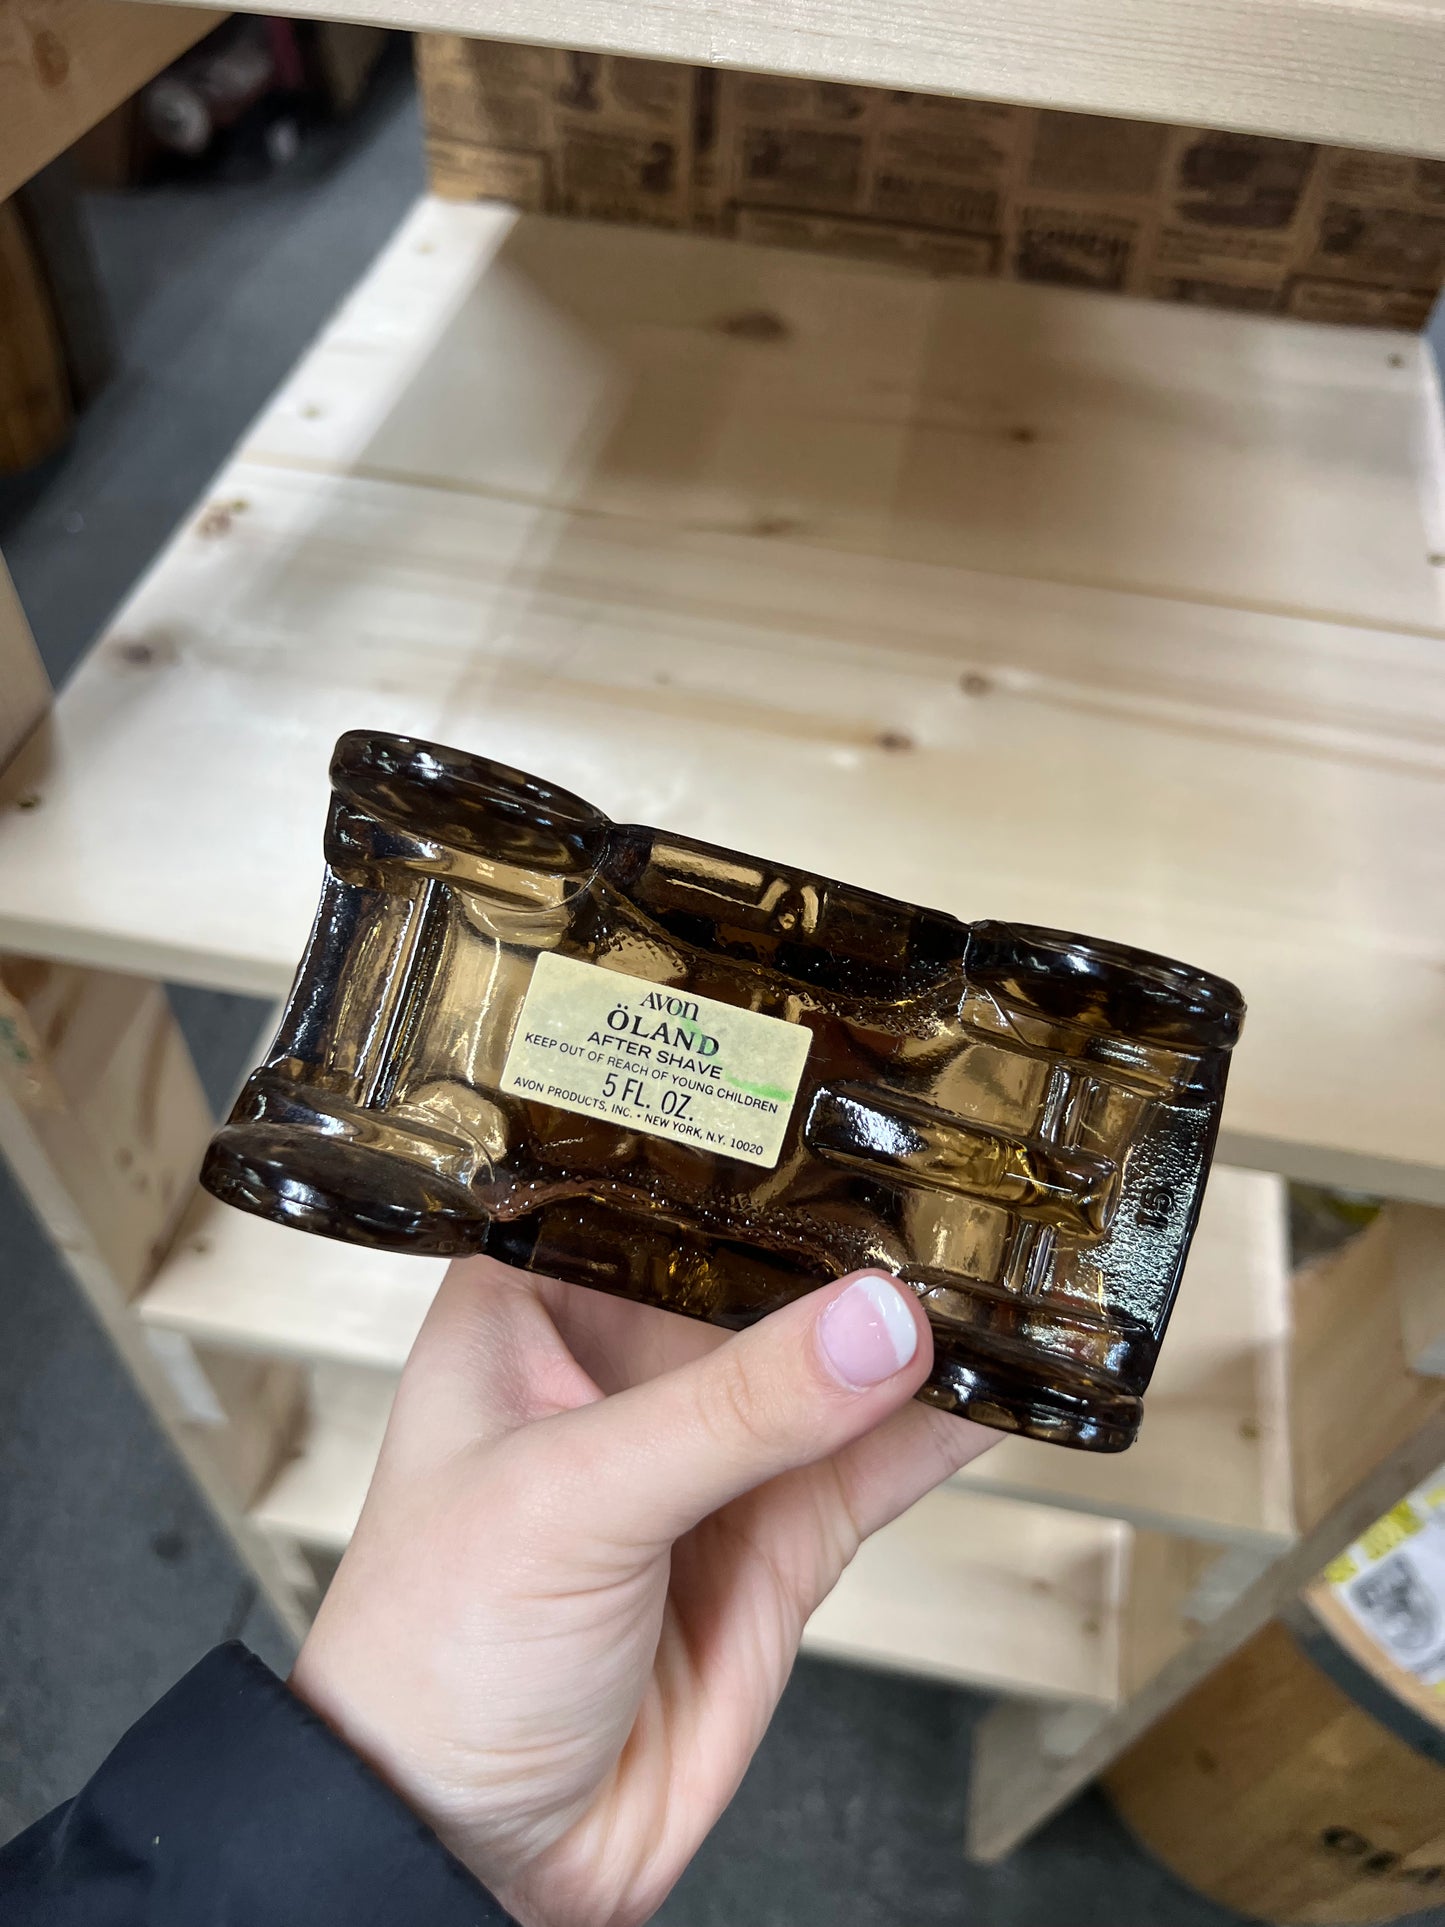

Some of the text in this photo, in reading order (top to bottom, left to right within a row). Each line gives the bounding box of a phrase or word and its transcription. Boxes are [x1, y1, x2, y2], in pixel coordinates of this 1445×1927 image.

[587, 1031, 723, 1080] AFTER SHAVE
[606, 1003, 720, 1057] ÖLAND
[524, 1032, 779, 1114] KEEP OUT OF REACH OF YOUNG CHILDREN
[602, 1072, 694, 1121] 5 FL. OZ.
[513, 1076, 764, 1155] AVON PRODUCTS, INC. NEW YORK, N.Y. 10020
